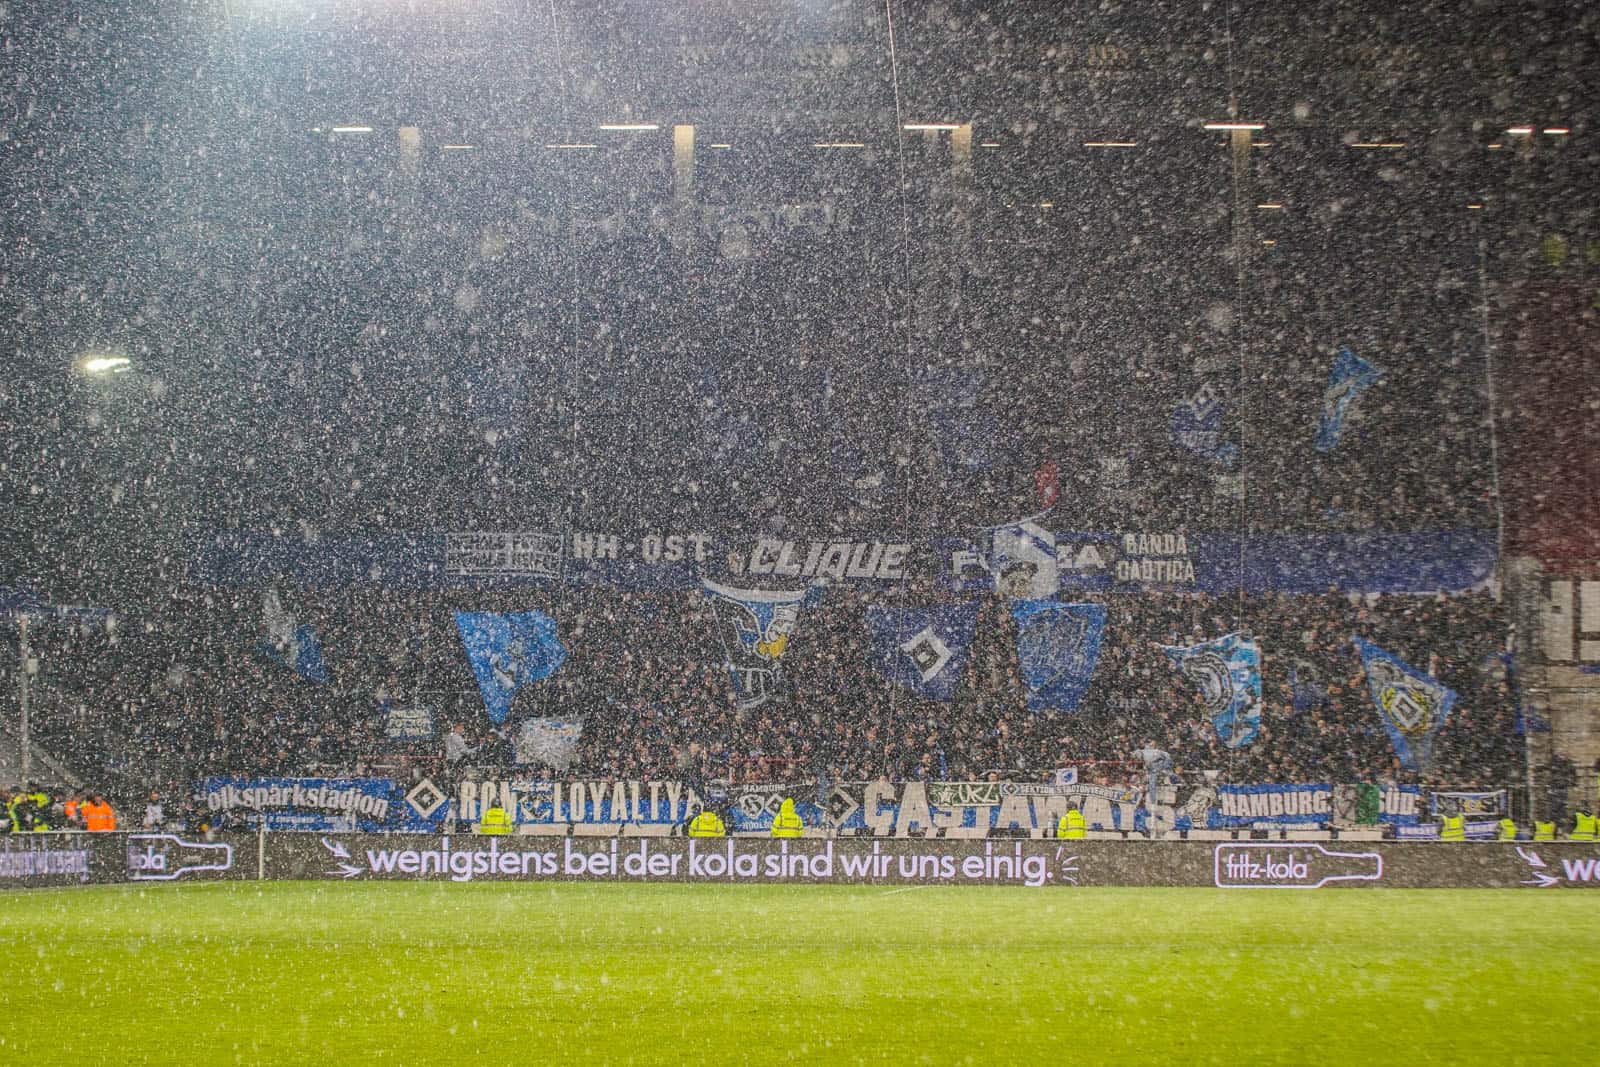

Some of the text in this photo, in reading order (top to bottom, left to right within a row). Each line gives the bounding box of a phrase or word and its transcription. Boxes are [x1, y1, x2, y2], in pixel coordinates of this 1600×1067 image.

[749, 539, 912, 579] CLIQUE
[1124, 534, 1188, 555] BANDA
[199, 784, 388, 818] olksparkstadion
[553, 781, 684, 823] LOYALTY
[1222, 790, 1328, 817] HAMBURG
[367, 837, 1053, 886] wenigstens bei der kola sind wir uns einig.
[1226, 853, 1308, 879] fritz-kola
